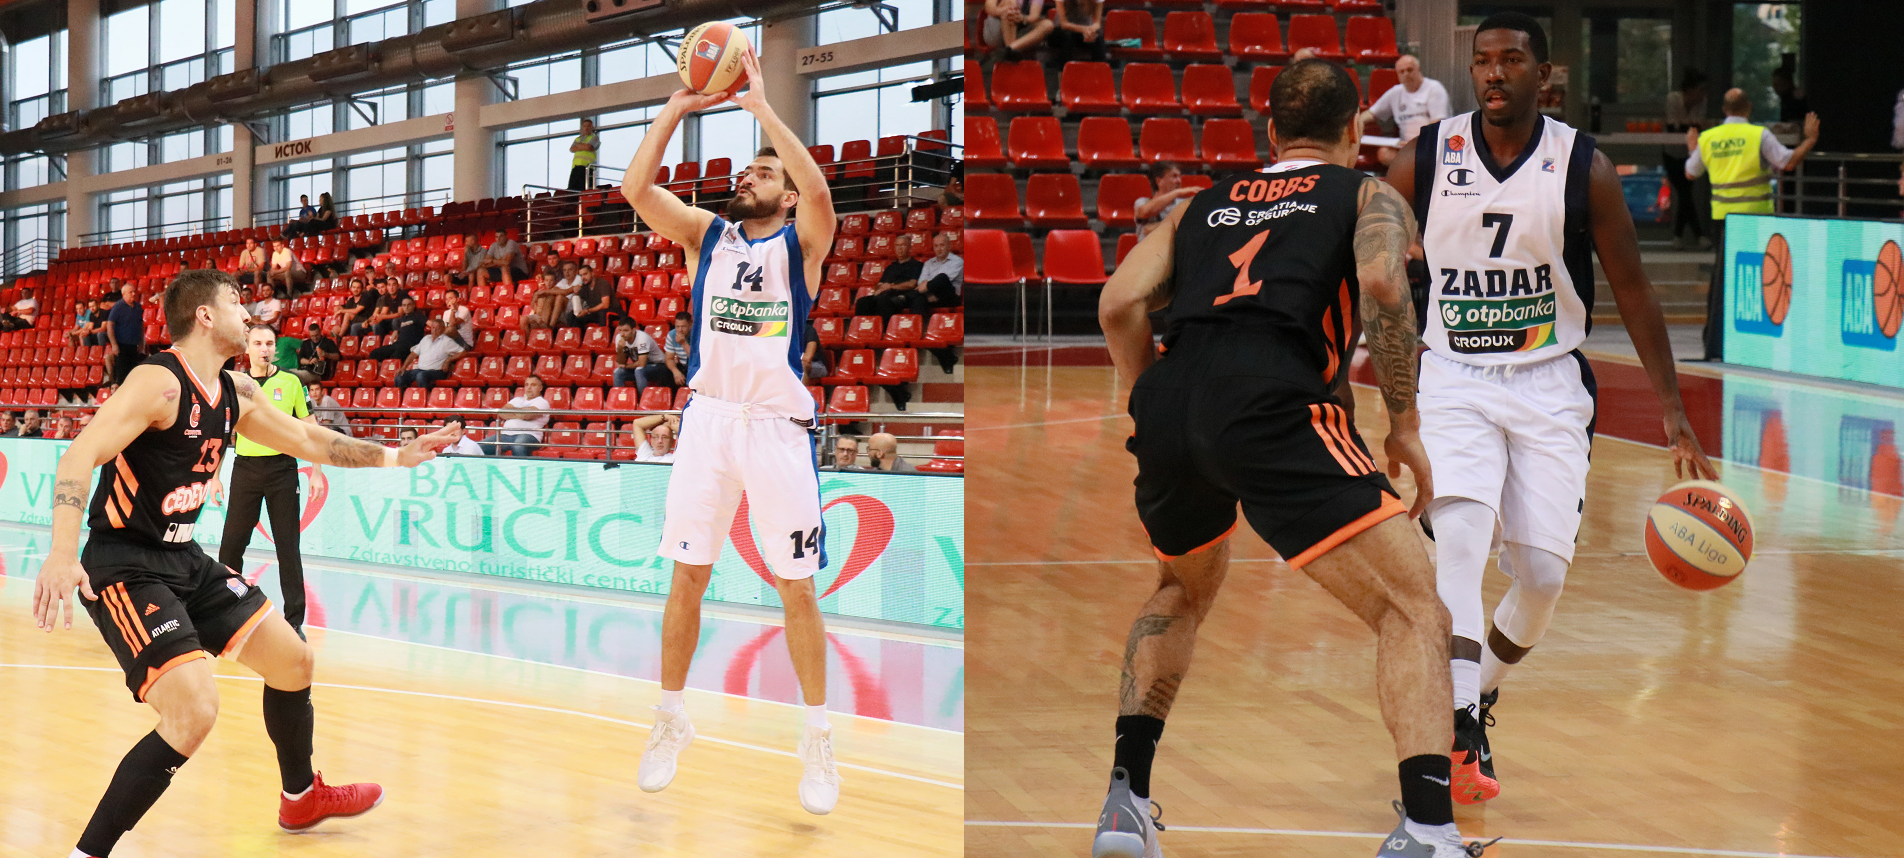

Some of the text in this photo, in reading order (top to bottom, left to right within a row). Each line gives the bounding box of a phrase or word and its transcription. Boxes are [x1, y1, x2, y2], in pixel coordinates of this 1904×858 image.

[802, 52, 834, 66] 27-55
[275, 140, 312, 159] ИСТОК
[1444, 151, 1461, 164] ABA
[1229, 174, 1321, 203] COBBS
[1441, 189, 1481, 198] Champion
[1482, 213, 1514, 258] 7
[732, 261, 763, 292] 14
[1213, 229, 1271, 306] 1
[1441, 264, 1553, 298] ZADAR
[1736, 264, 1763, 322] ABA
[1843, 272, 1873, 335] ABA
[1454, 335, 1515, 348] CRODUX
[191, 438, 223, 473] 13
[409, 462, 592, 508] BANJA
[1683, 492, 1748, 544] SPALDING
[790, 526, 819, 560] 14
[1669, 521, 1728, 565] ABA Liga
[350, 545, 471, 572] Zdravstveno
[584, 573, 666, 595] centar
[151, 619, 180, 638] ATLANTIC
